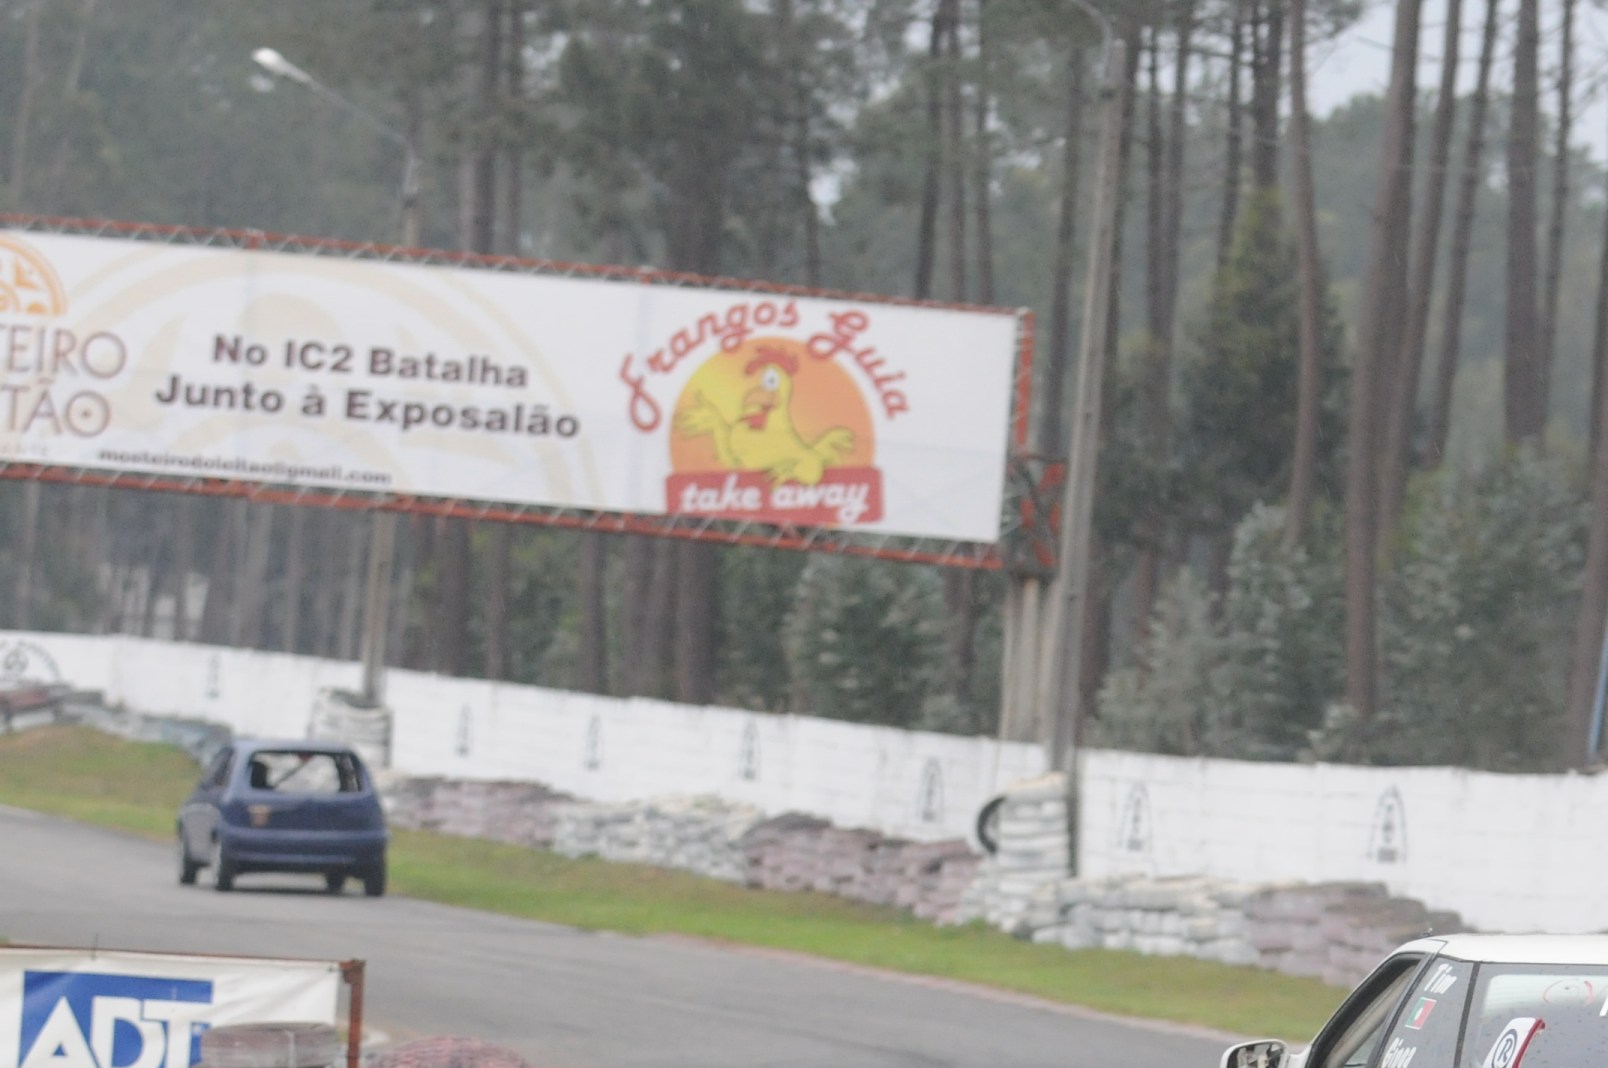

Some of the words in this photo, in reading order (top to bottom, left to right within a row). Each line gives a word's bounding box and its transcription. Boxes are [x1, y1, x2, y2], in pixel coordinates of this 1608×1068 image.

[0, 324, 128, 380] EIRO
[212, 334, 269, 368] No
[284, 340, 354, 374] IC2
[368, 346, 530, 390] Batalha
[616, 298, 800, 434] Frangos
[155, 374, 286, 415] Junto
[300, 384, 327, 418] à
[345, 389, 582, 440] Exposalão
[680, 475, 764, 513] take
[772, 479, 871, 523] away
